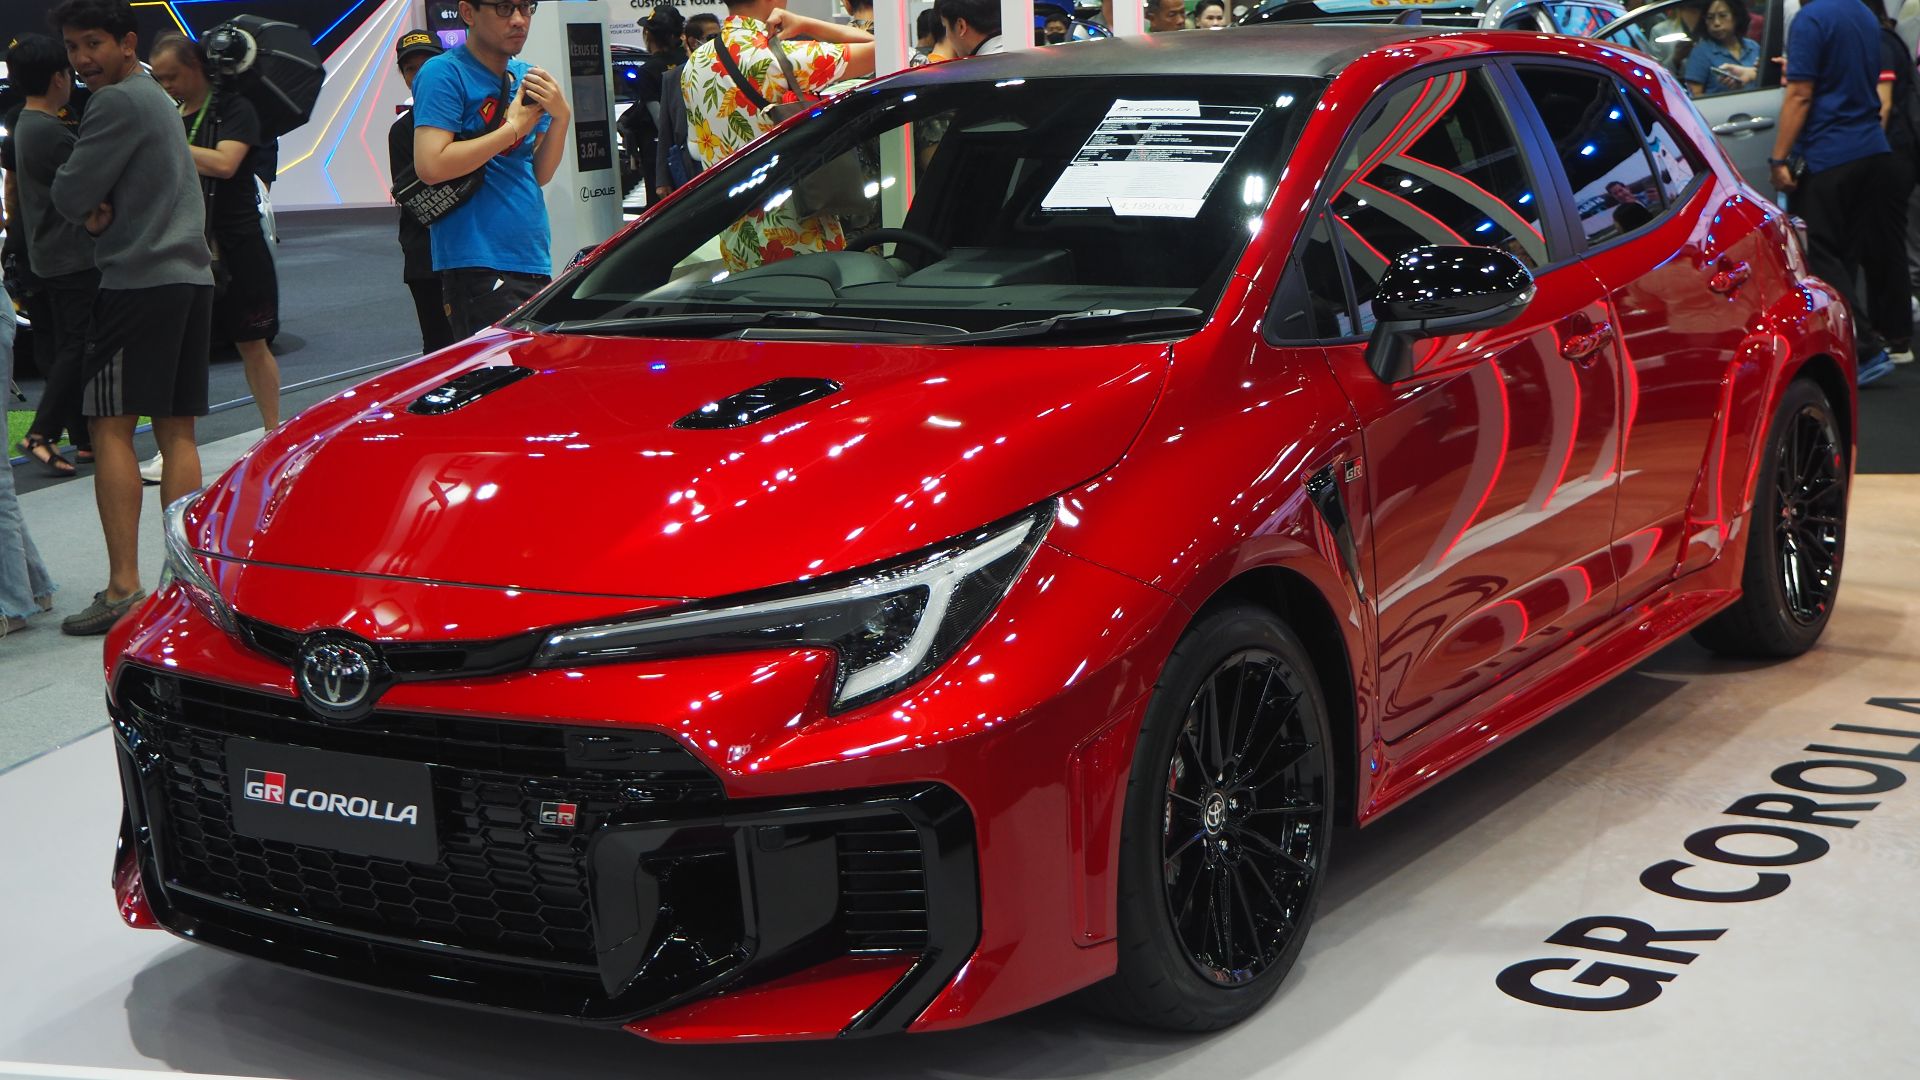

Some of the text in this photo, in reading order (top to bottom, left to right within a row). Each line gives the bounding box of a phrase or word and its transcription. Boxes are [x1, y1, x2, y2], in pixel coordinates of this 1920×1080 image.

[448, 10, 458, 19] tv
[570, 44, 590, 56] LEXUS
[580, 142, 597, 158] 3.87
[590, 186, 616, 198] LEXUS
[289, 788, 418, 825] COROLLA
[1495, 915, 1729, 1012] GR
